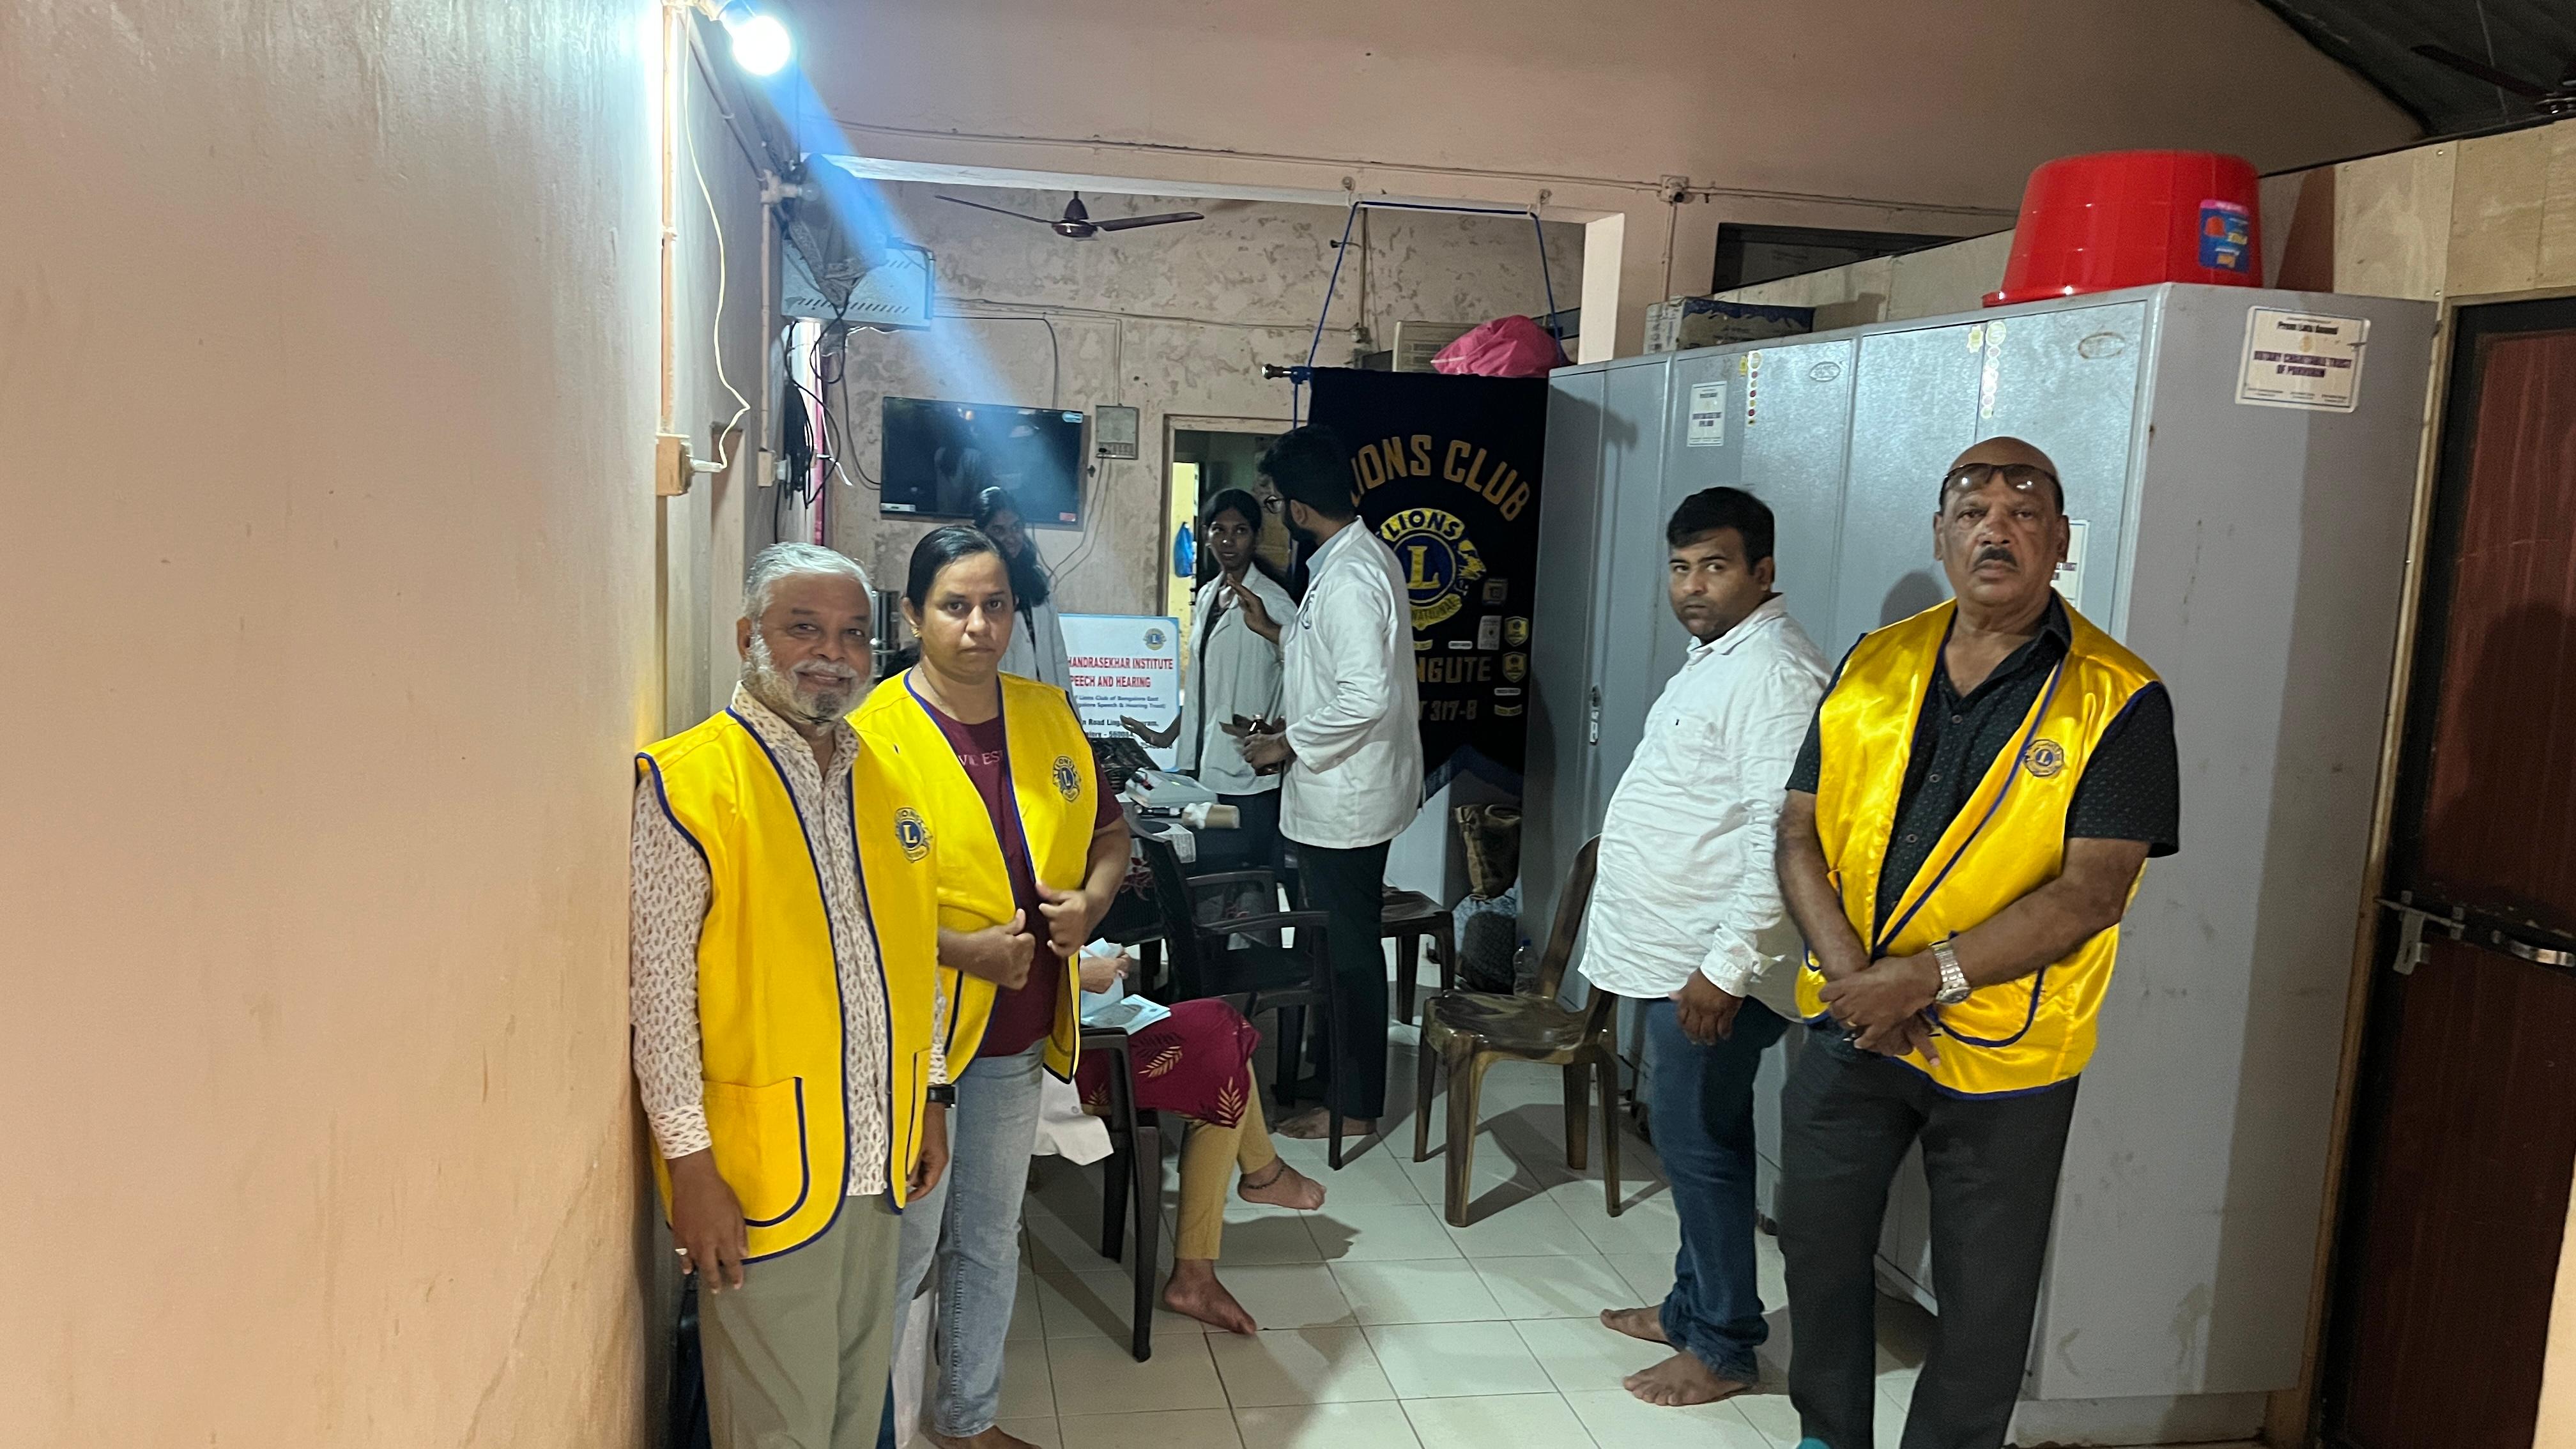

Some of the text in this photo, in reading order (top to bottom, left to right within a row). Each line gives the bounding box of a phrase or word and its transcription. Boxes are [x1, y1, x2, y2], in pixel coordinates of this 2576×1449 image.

[1350, 434, 1531, 521] IONS CLUB
[1384, 510, 1460, 538] LIONS
[1406, 545, 1441, 590] L
[1068, 657, 1173, 670] HANDRASEKHAR INSTITUTE
[1416, 656, 1492, 684] NGUTE
[1070, 675, 1151, 688] PEECH AND HEARING
[902, 824, 918, 843] L
